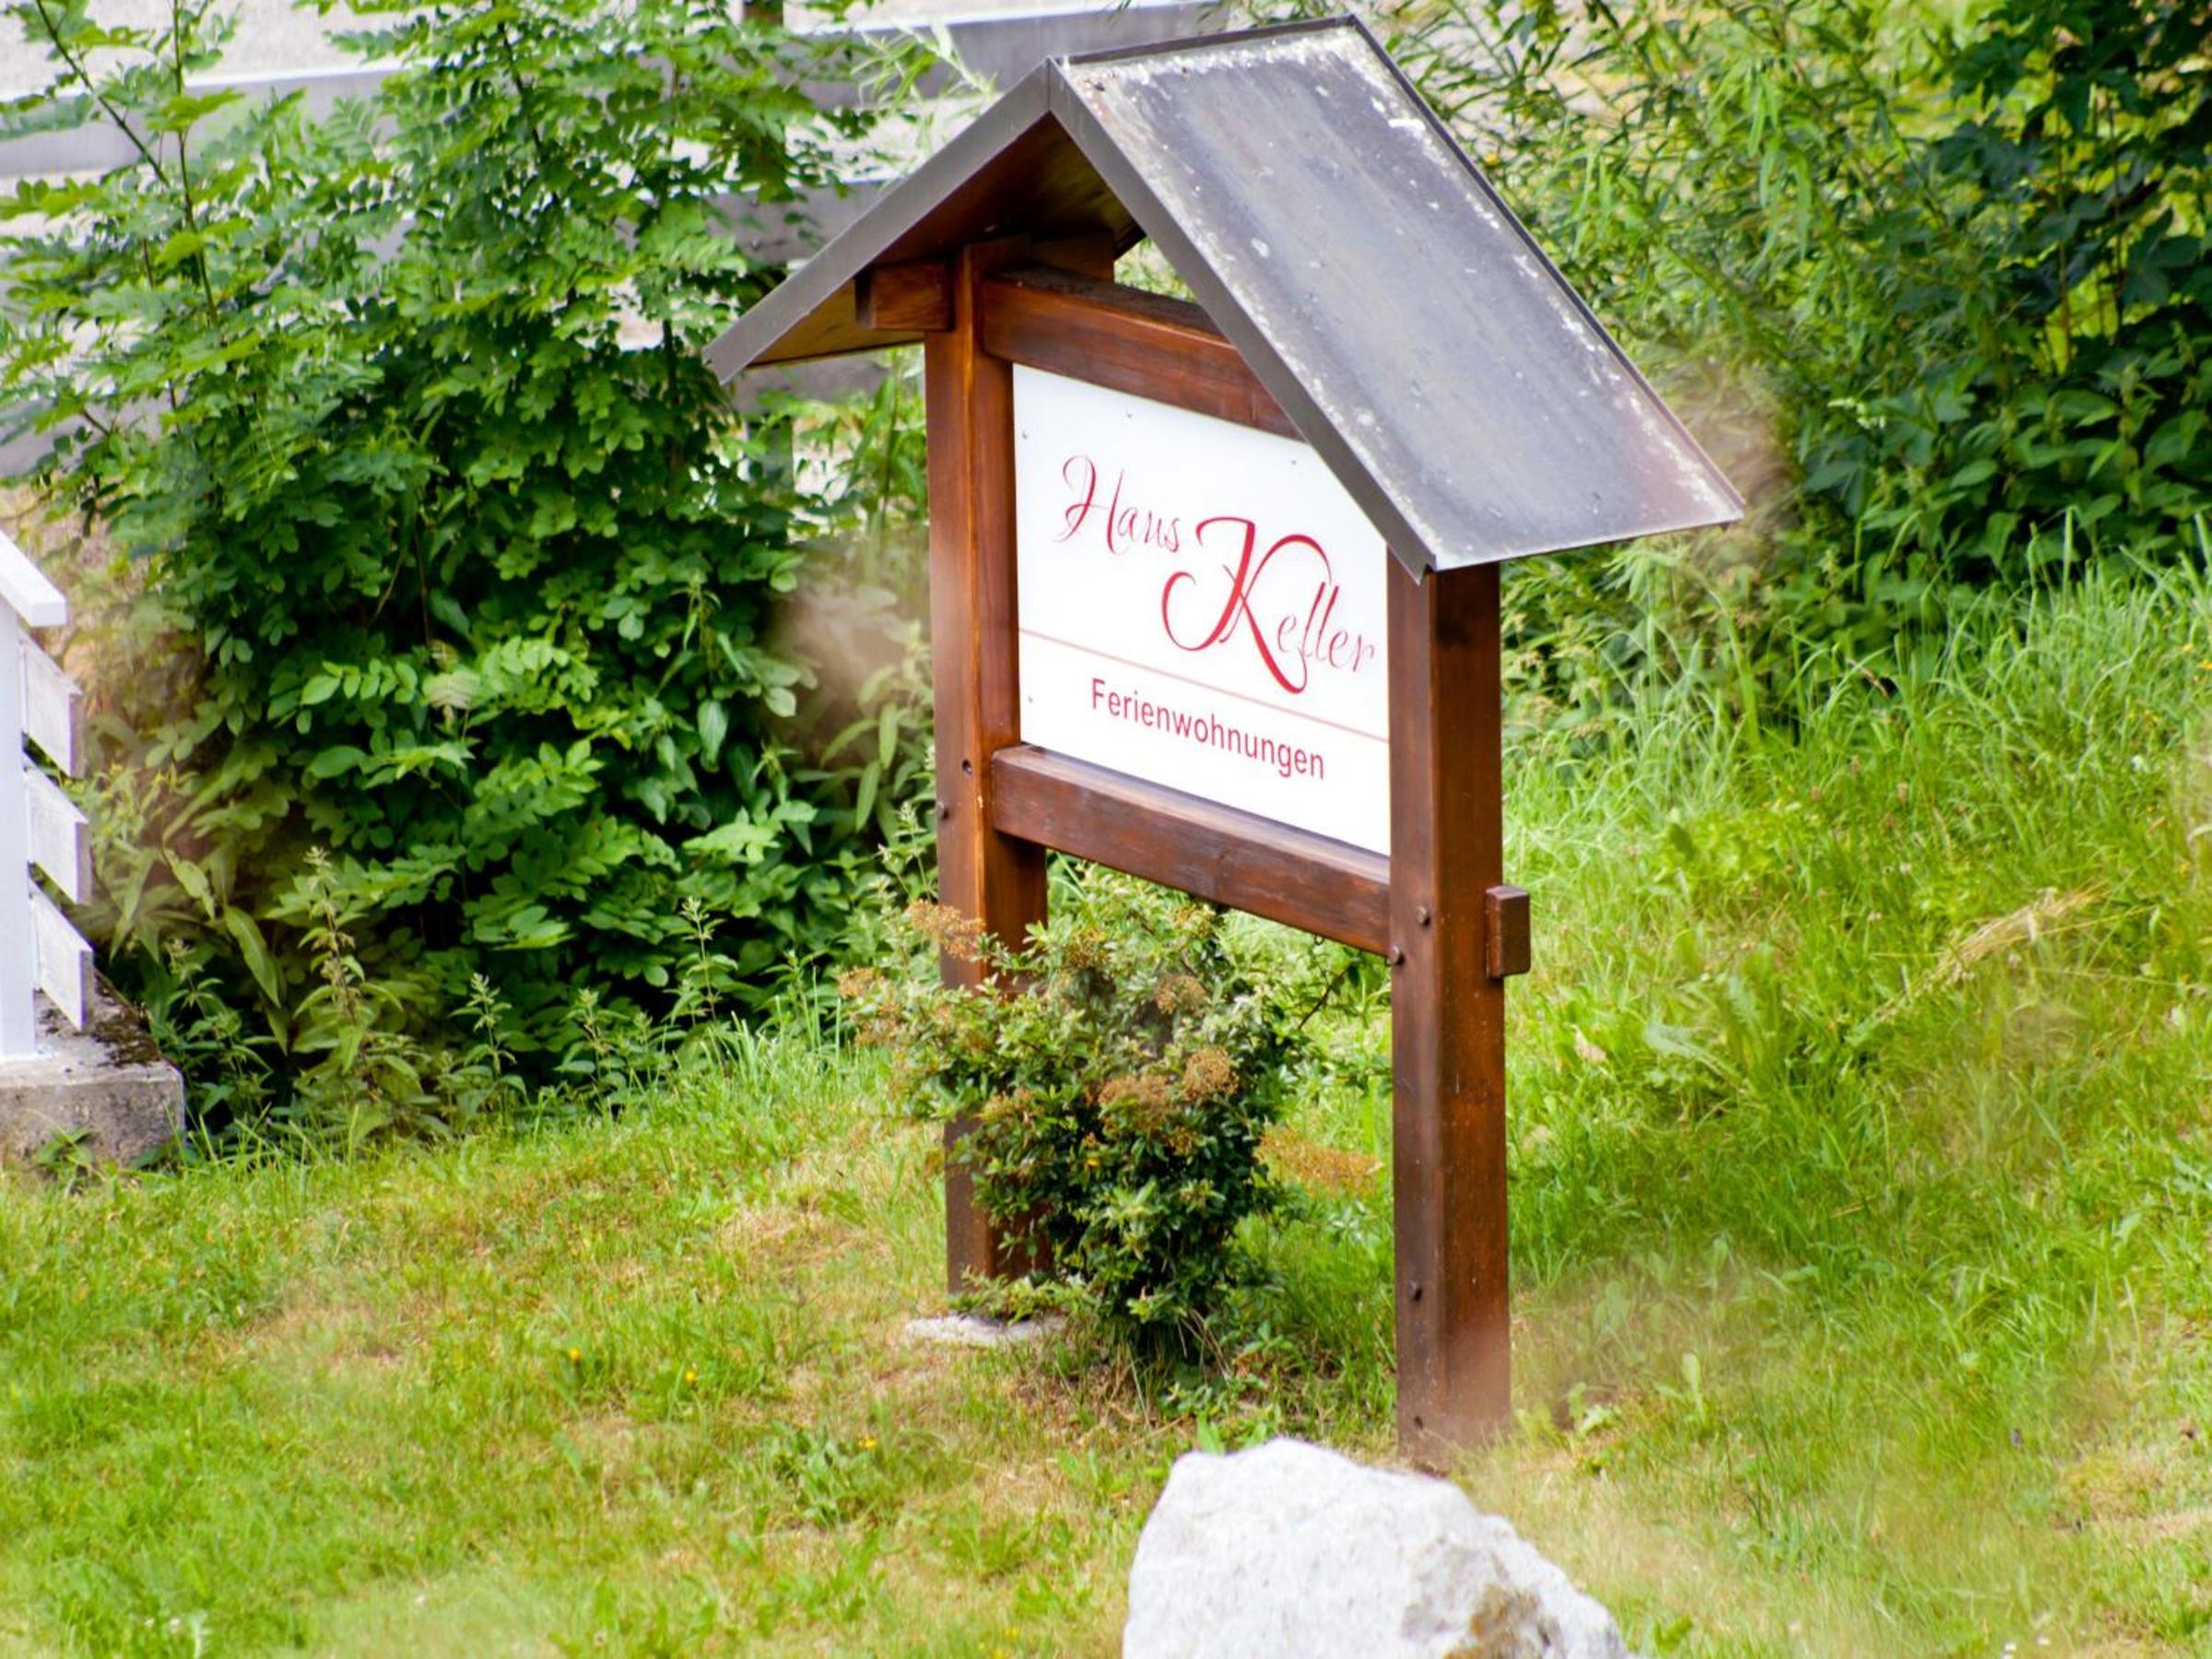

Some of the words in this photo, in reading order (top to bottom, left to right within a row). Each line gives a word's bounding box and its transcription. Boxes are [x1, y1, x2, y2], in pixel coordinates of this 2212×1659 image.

[1053, 455, 1181, 555] Haus
[1161, 516, 1376, 695] Keller
[1091, 677, 1326, 780] Ferienwohnungen
